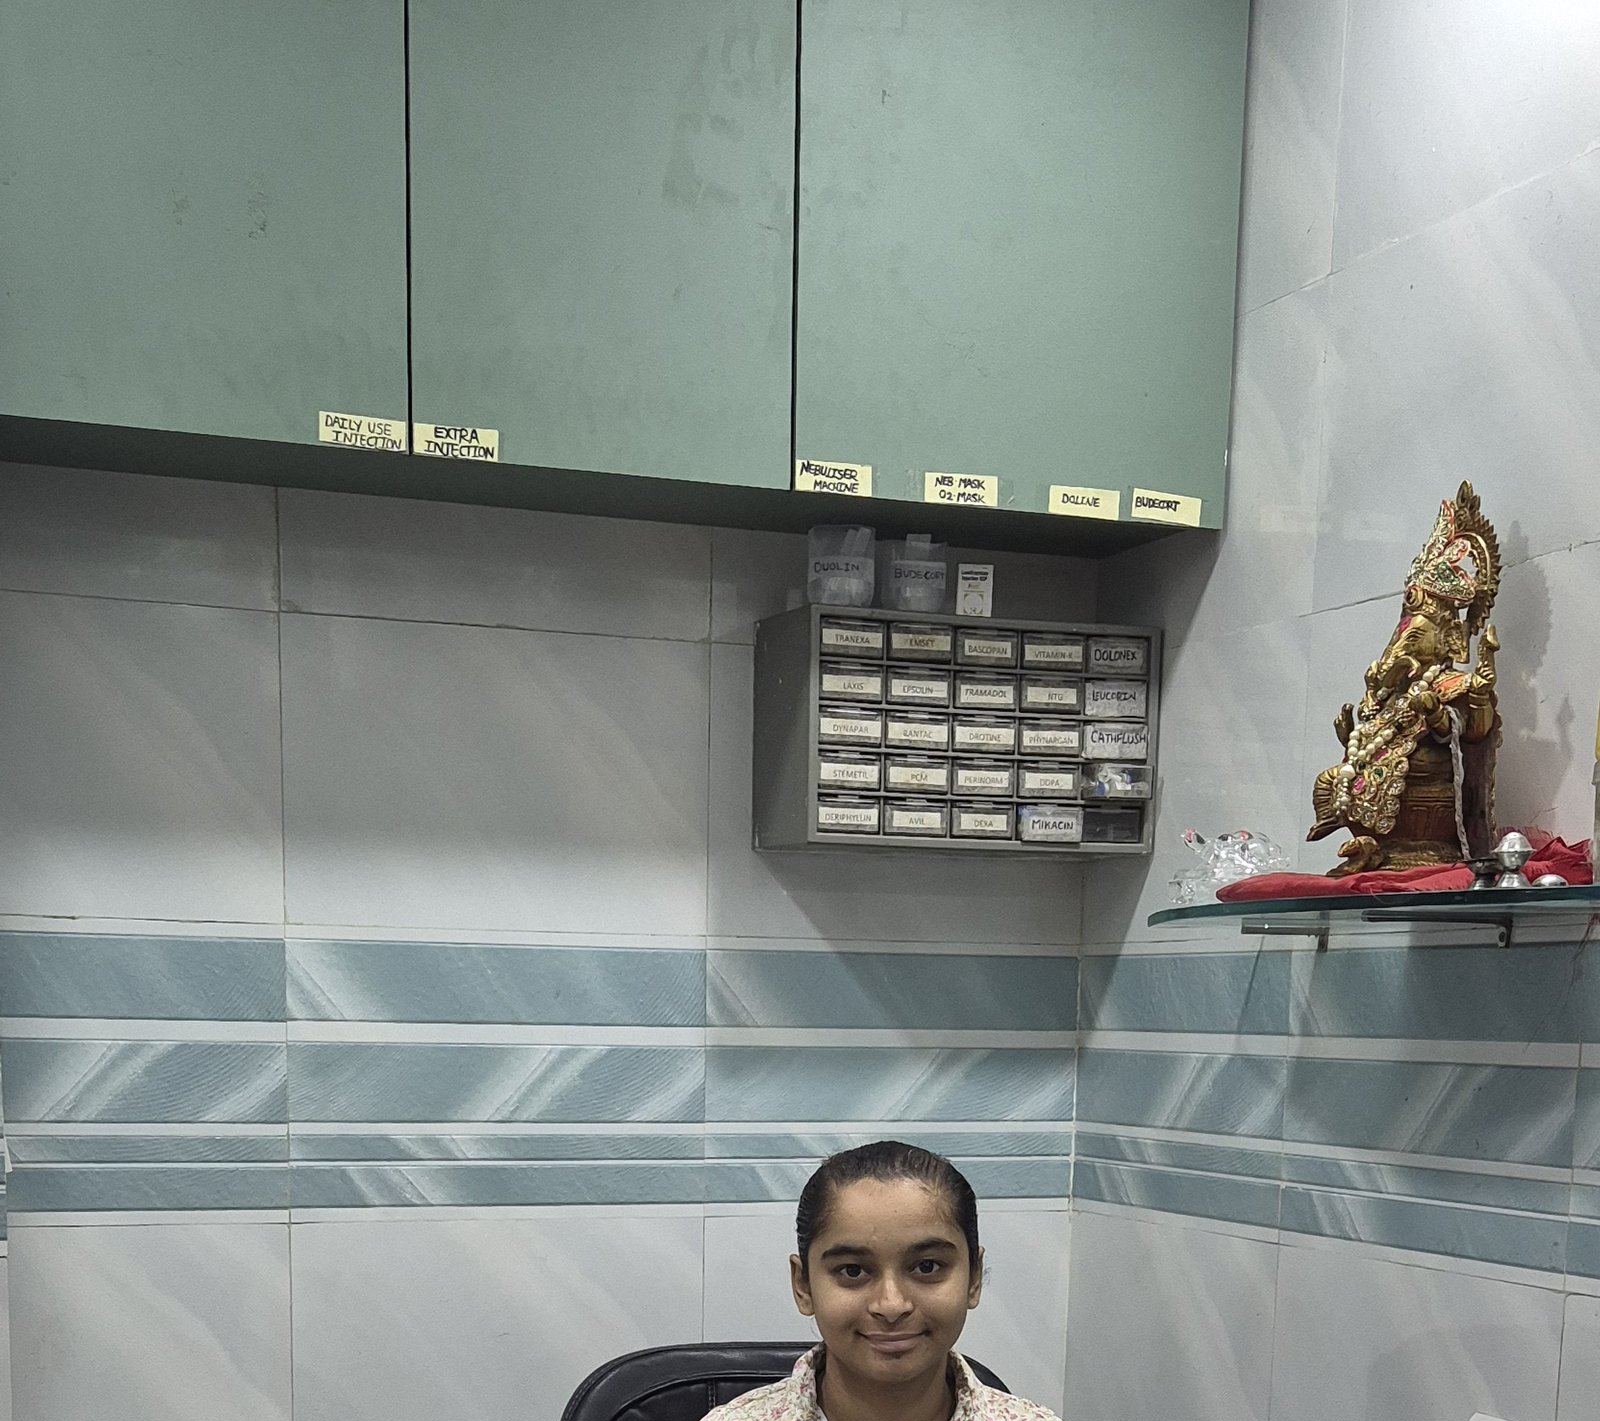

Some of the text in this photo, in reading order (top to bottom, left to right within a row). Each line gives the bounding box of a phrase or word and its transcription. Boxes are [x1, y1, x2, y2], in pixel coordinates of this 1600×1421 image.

[325, 414, 392, 436] DAILY USE
[332, 430, 402, 450] INJECTION
[434, 426, 479, 444] EXTRA
[424, 440, 495, 459] INJECTION
[800, 460, 858, 481] NEBULISER
[814, 562, 859, 572] DUOLIN
[835, 634, 870, 644] TRANEXA
[1034, 651, 1072, 659] VITAMIN-K
[965, 688, 1007, 697] TRAMADOL
[1048, 693, 1063, 701] NTG
[1091, 730, 1146, 745] CATHFLUSH
[833, 770, 868, 779] STEMETIL
[1031, 819, 1074, 830] MIKACIN
